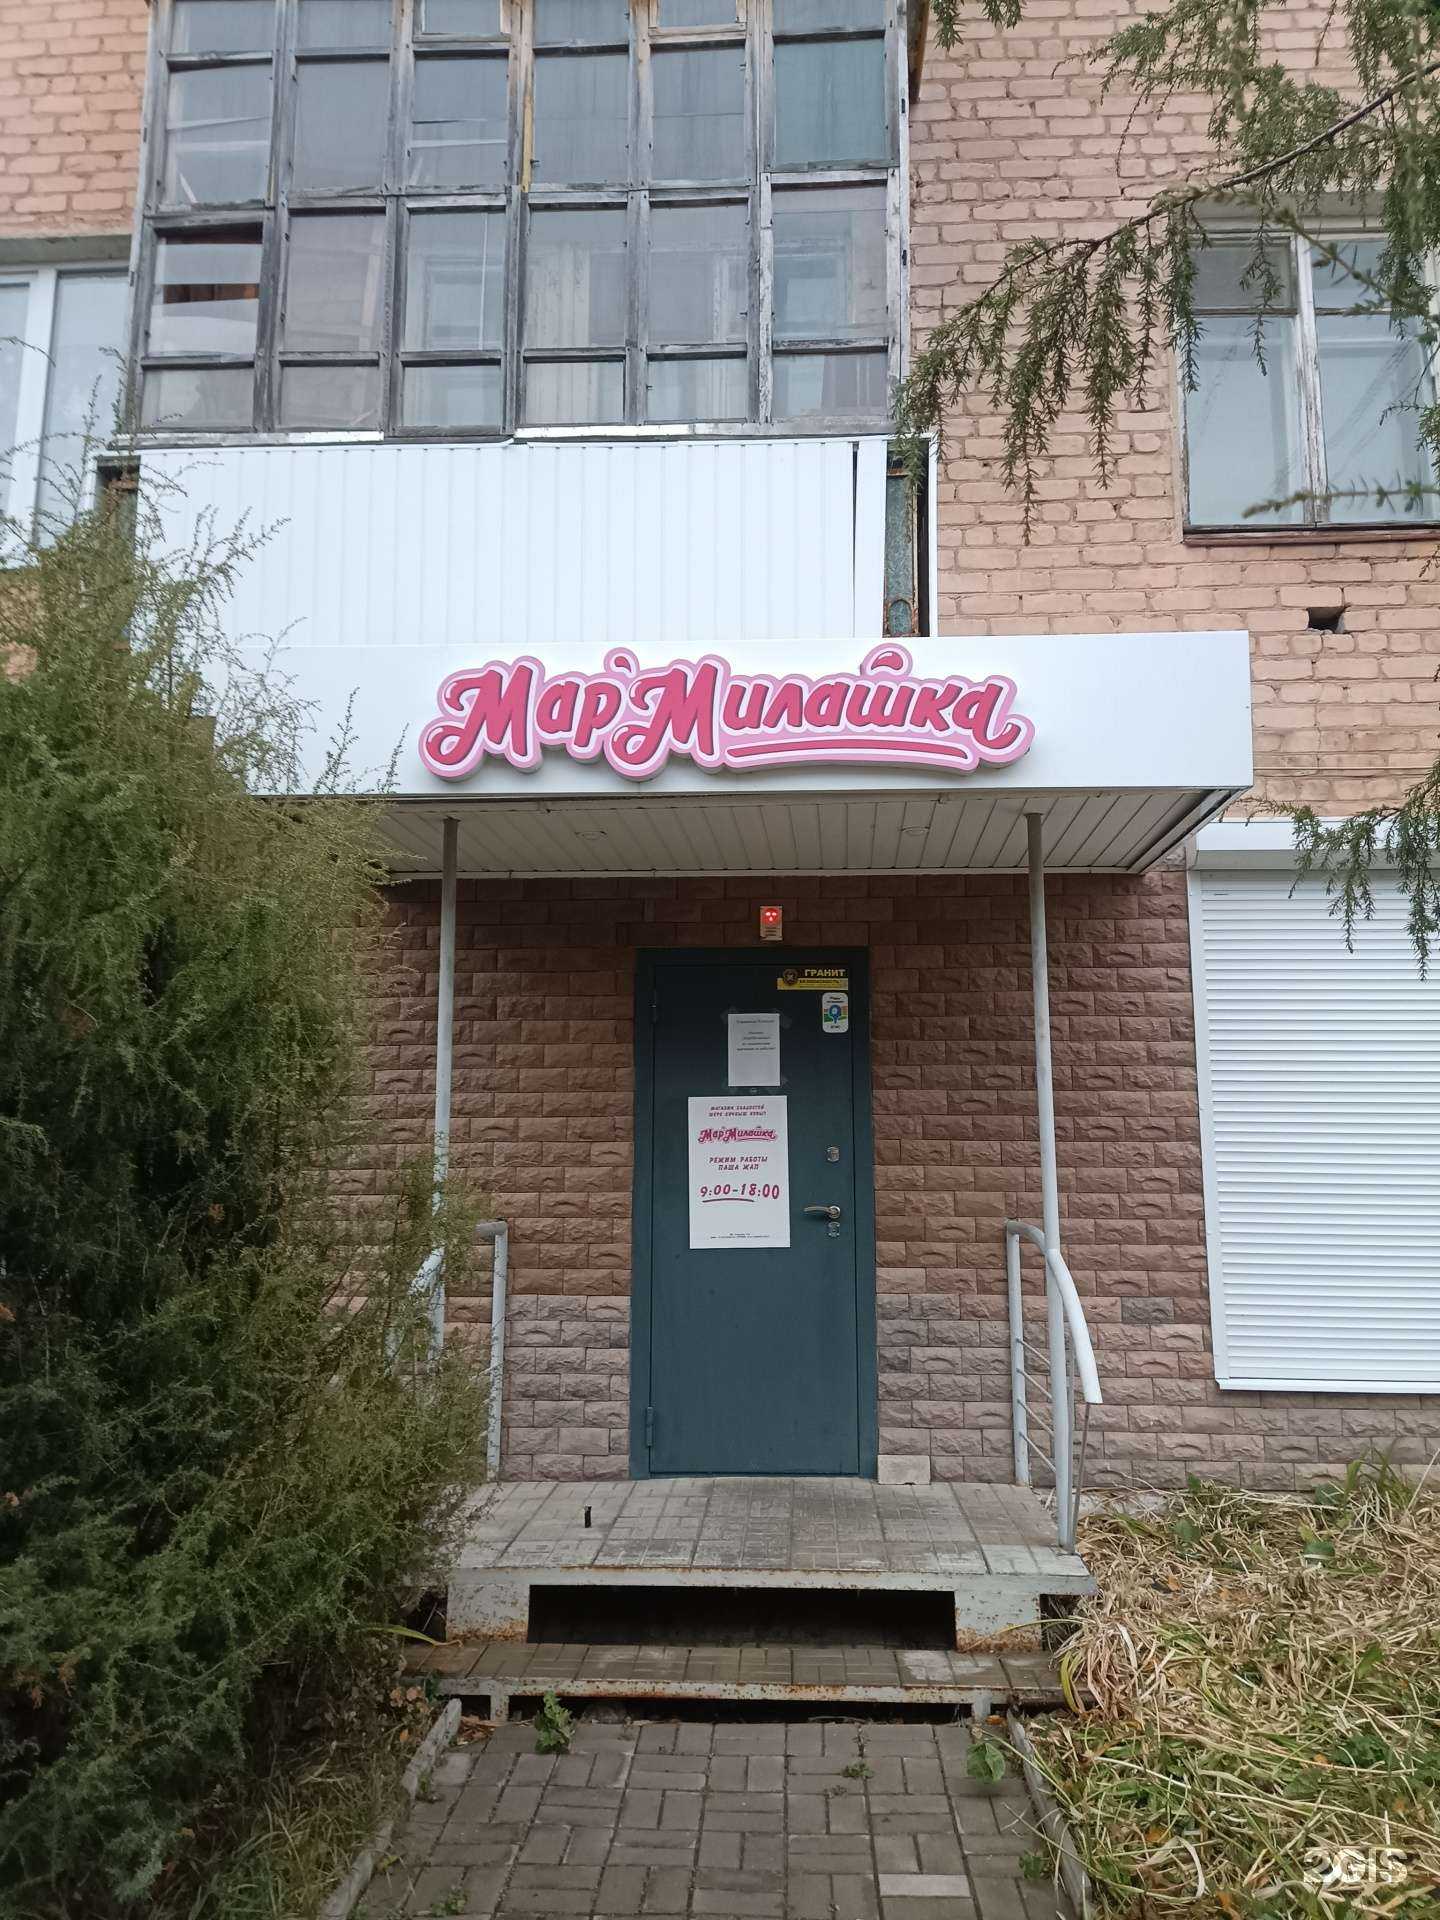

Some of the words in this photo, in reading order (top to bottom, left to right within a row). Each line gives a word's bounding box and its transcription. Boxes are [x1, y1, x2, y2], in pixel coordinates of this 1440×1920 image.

[804, 968, 846, 977] ГРАНИТ
[708, 1156, 736, 1164] РЕЖИМ
[739, 1155, 768, 1163] РАБОТЫ
[700, 1182, 780, 1200] 9:00-18:00
